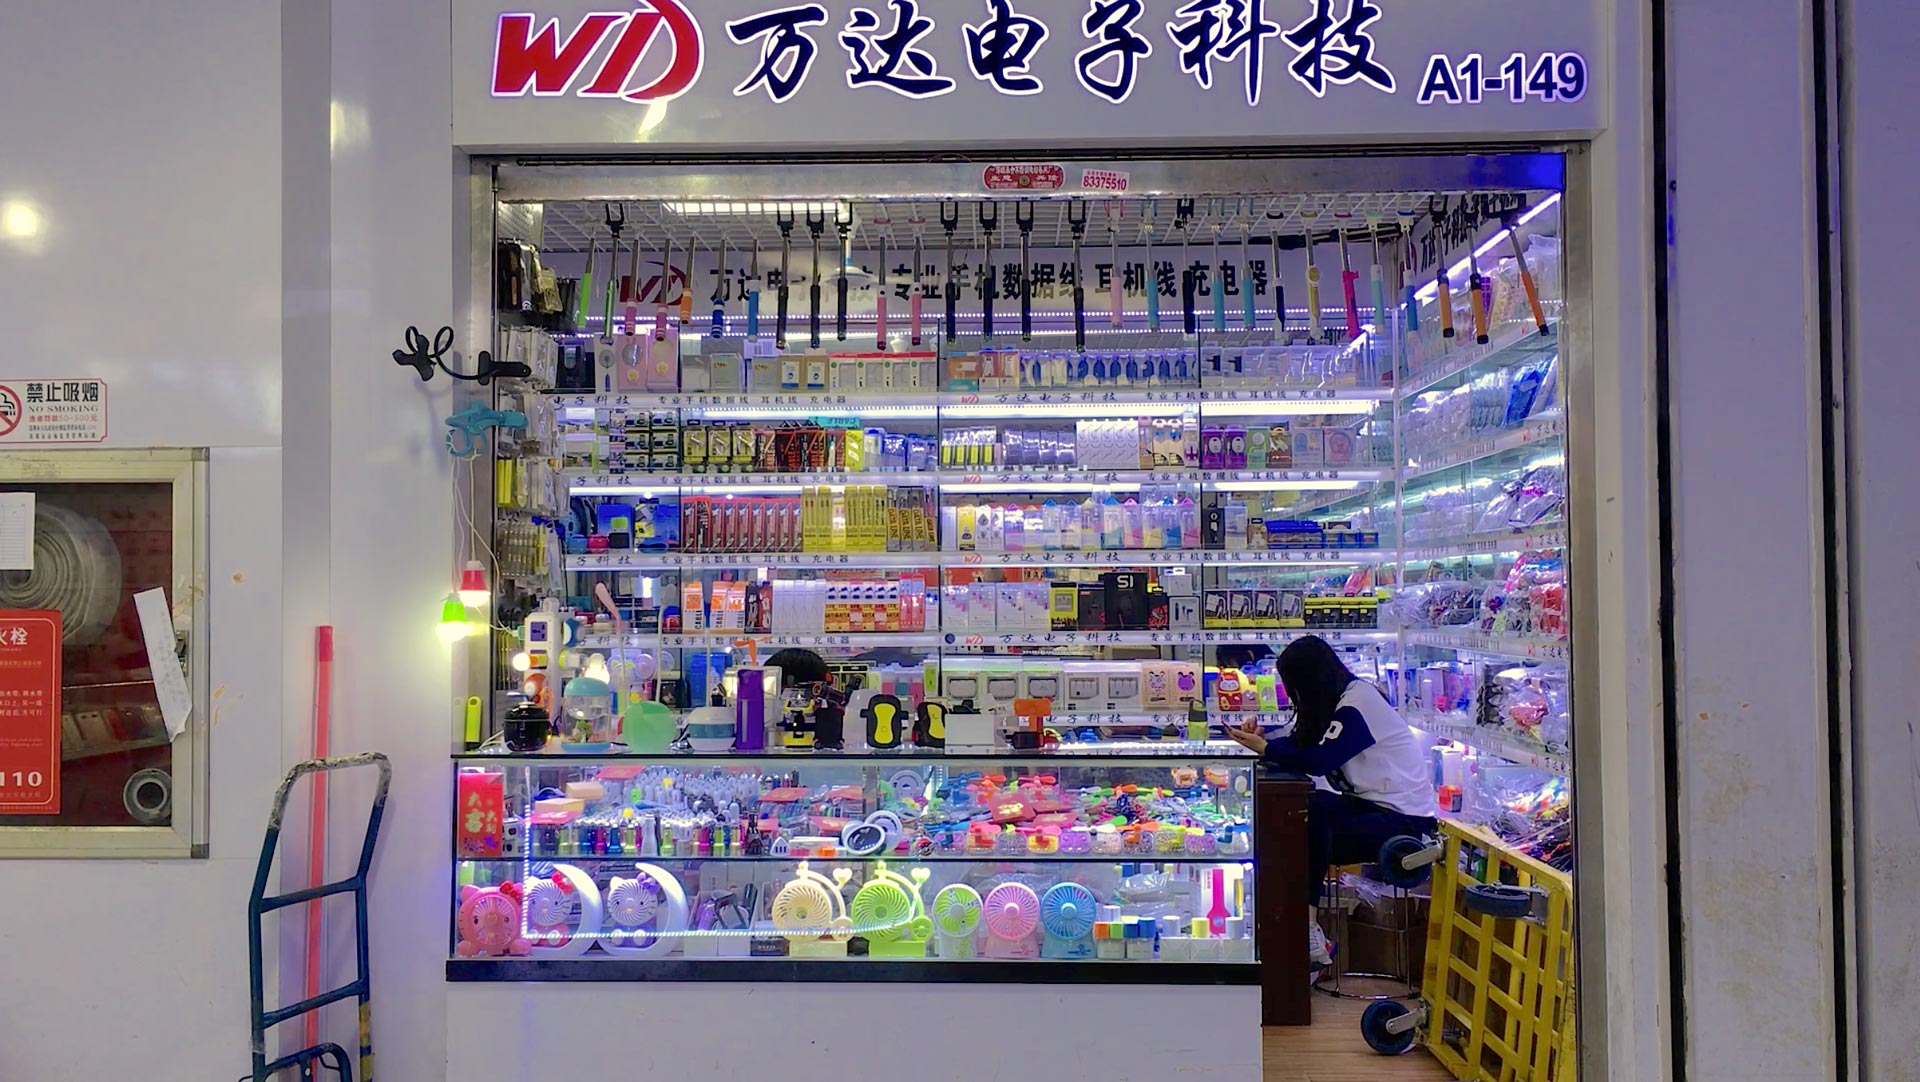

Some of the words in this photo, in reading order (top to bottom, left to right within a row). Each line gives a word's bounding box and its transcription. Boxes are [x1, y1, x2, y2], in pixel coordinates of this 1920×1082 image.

[493, 0, 703, 100] WD
[730, 0, 1395, 105] 万达电子科技
[1419, 54, 1586, 103] A1-149
[1083, 176, 1127, 191] 83375510
[26, 382, 99, 402] 禁止吸烟
[995, 391, 1119, 403] 万达电子科技
[1146, 390, 1238, 400] 专业手机数据线
[1250, 390, 1287, 399] 耳机线
[1299, 389, 1337, 399] 充电器
[659, 396, 750, 404] 专业手机数据线
[761, 396, 798, 404] 耳机线
[810, 396, 847, 404] 充电器
[660, 476, 750, 485] 专业手机数据线
[763, 476, 800, 485] 耳机线
[812, 476, 848, 485] 充电器
[1000, 472, 1120, 483] 万达电子科技
[1147, 471, 1240, 481] 专业手机数据线
[1252, 471, 1289, 480] 耳机线
[1301, 470, 1339, 480] 充电器
[660, 555, 751, 564] 专业手机数据线
[764, 555, 801, 564] 耳机线
[812, 555, 849, 563] 充电器
[1000, 552, 1121, 562] 万达电子科技
[1149, 551, 1241, 561] 专业手机数据线
[1253, 551, 1291, 561] 耳机线
[1303, 551, 1340, 560] 充电器
[813, 636, 849, 645] 充电器
[1001, 633, 1122, 643] 万达电子科技
[1150, 632, 1243, 642] 专业手机数据线
[1255, 632, 1292, 641] 耳机线
